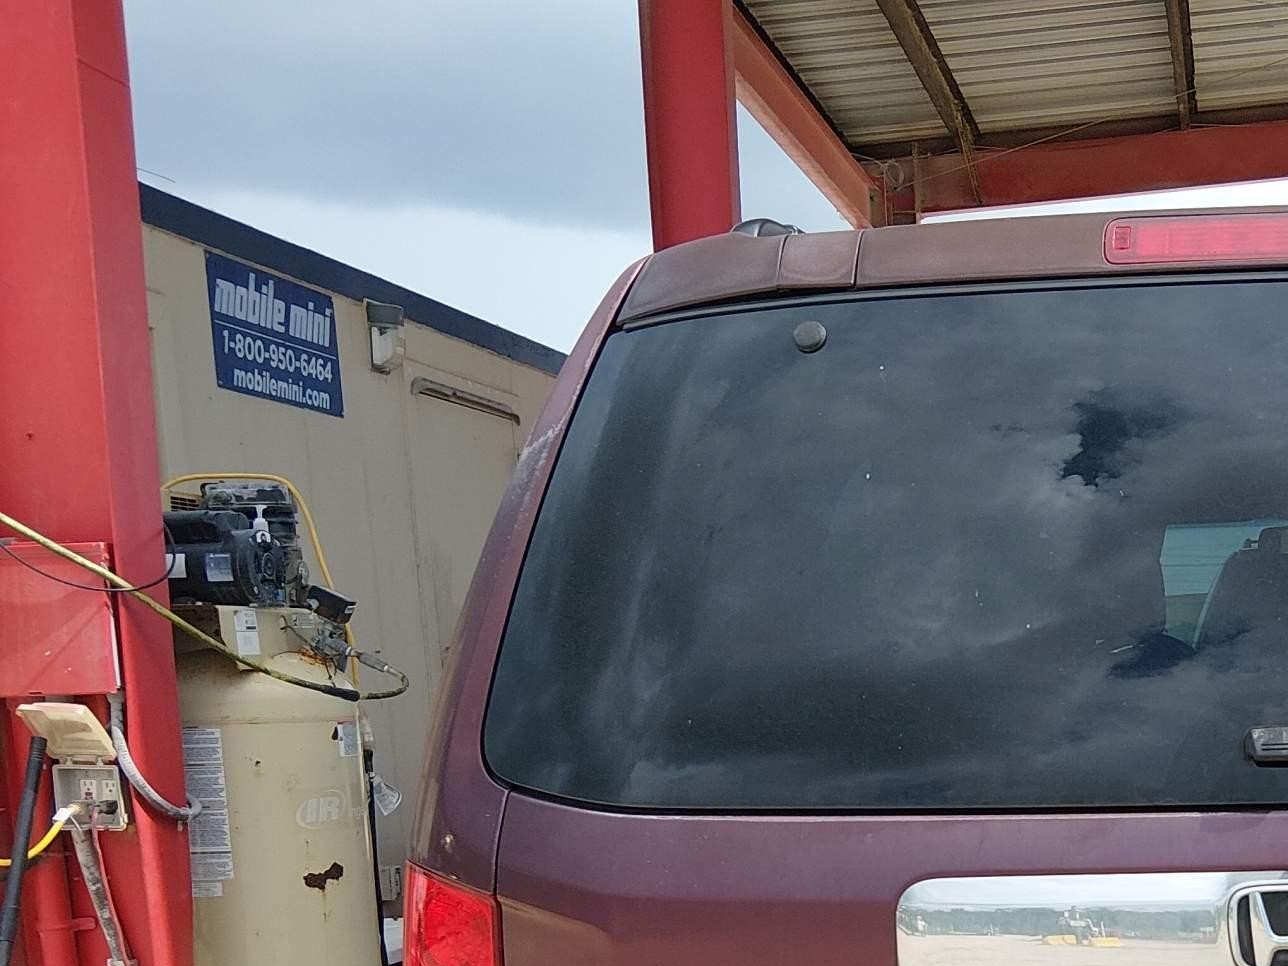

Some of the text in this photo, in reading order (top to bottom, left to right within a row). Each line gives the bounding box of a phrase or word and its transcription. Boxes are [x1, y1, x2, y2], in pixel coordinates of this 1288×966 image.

[214, 272, 333, 347] mobile mini
[222, 329, 333, 383] 1-800-950-6464
[233, 368, 330, 410] mobilemini.com
